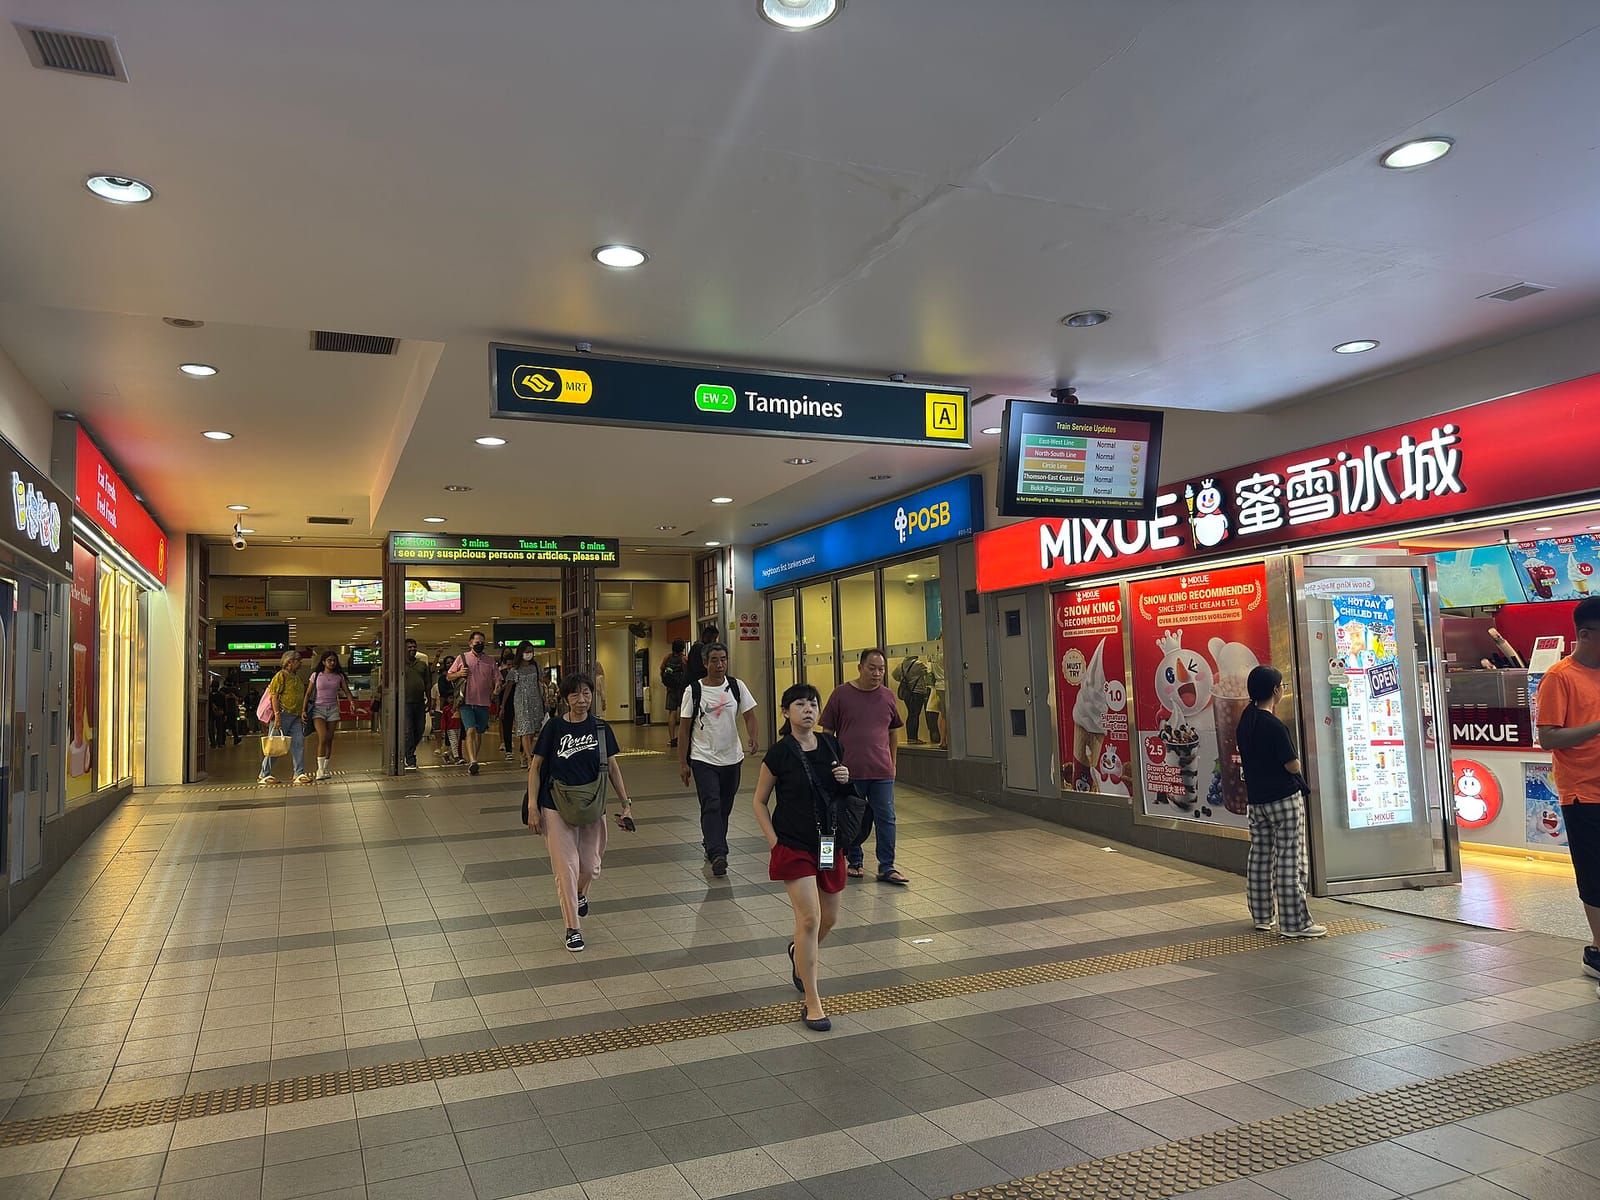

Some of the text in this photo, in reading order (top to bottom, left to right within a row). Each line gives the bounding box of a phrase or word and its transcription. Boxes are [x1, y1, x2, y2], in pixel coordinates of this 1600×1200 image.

[565, 381, 587, 392] MRT
[703, 392, 729, 405] EW 2
[745, 391, 843, 419] Tampines
[939, 407, 951, 424] A
[1056, 421, 1117, 434] Train Service Updates
[1039, 438, 1063, 446] East-West
[1097, 441, 1116, 449] Normal
[1034, 449, 1065, 458] North-South
[1042, 461, 1057, 469] Circle
[1095, 464, 1114, 472] Normal
[1023, 472, 1058, 481] Thomson-East
[1059, 474, 1073, 482] Coast
[1094, 476, 1113, 484] Normal
[1235, 423, 1461, 535] 蜜雪冰城
[1045, 485, 1066, 493] Panjang
[1093, 487, 1112, 495] Normal
[907, 501, 951, 535] POSB
[1040, 493, 1180, 570] MIXUE
[461, 538, 467, 547] 3
[469, 539, 489, 548] mins
[519, 540, 538, 549] Tuas
[540, 540, 557, 549] Link
[580, 541, 585, 550] 6
[587, 542, 605, 551] mins
[398, 550, 415, 558] see
[418, 550, 434, 559] any
[436, 549, 486, 560] suspicious
[488, 551, 524, 561] persons
[526, 552, 535, 560] or
[537, 551, 571, 562] articles,
[573, 552, 600, 562] please
[1187, 575, 1209, 585] MIXUE
[1143, 583, 1255, 606] SNOW KING RECOMMENDED
[1063, 601, 1115, 617] SNOW KING
[1158, 604, 1175, 613] SINCE
[1199, 600, 1220, 610] CREAM
[1227, 598, 1240, 607] TEA
[1347, 597, 1381, 609] HOT DAY
[1159, 617, 1172, 625] OVER
[1208, 611, 1241, 620] WORLDWIDE
[1340, 607, 1388, 620] CHILLED TEA
[1064, 614, 1116, 627] RECOMMENDED
[1066, 662, 1081, 670] MUST
[1069, 670, 1079, 678] TRY
[1371, 669, 1397, 691] OPEN
[1452, 723, 1519, 742] MIXUE
[1146, 764, 1181, 774] Brown Sugar
[1162, 774, 1183, 784] Sundae
[1374, 812, 1395, 821] MIXUE
